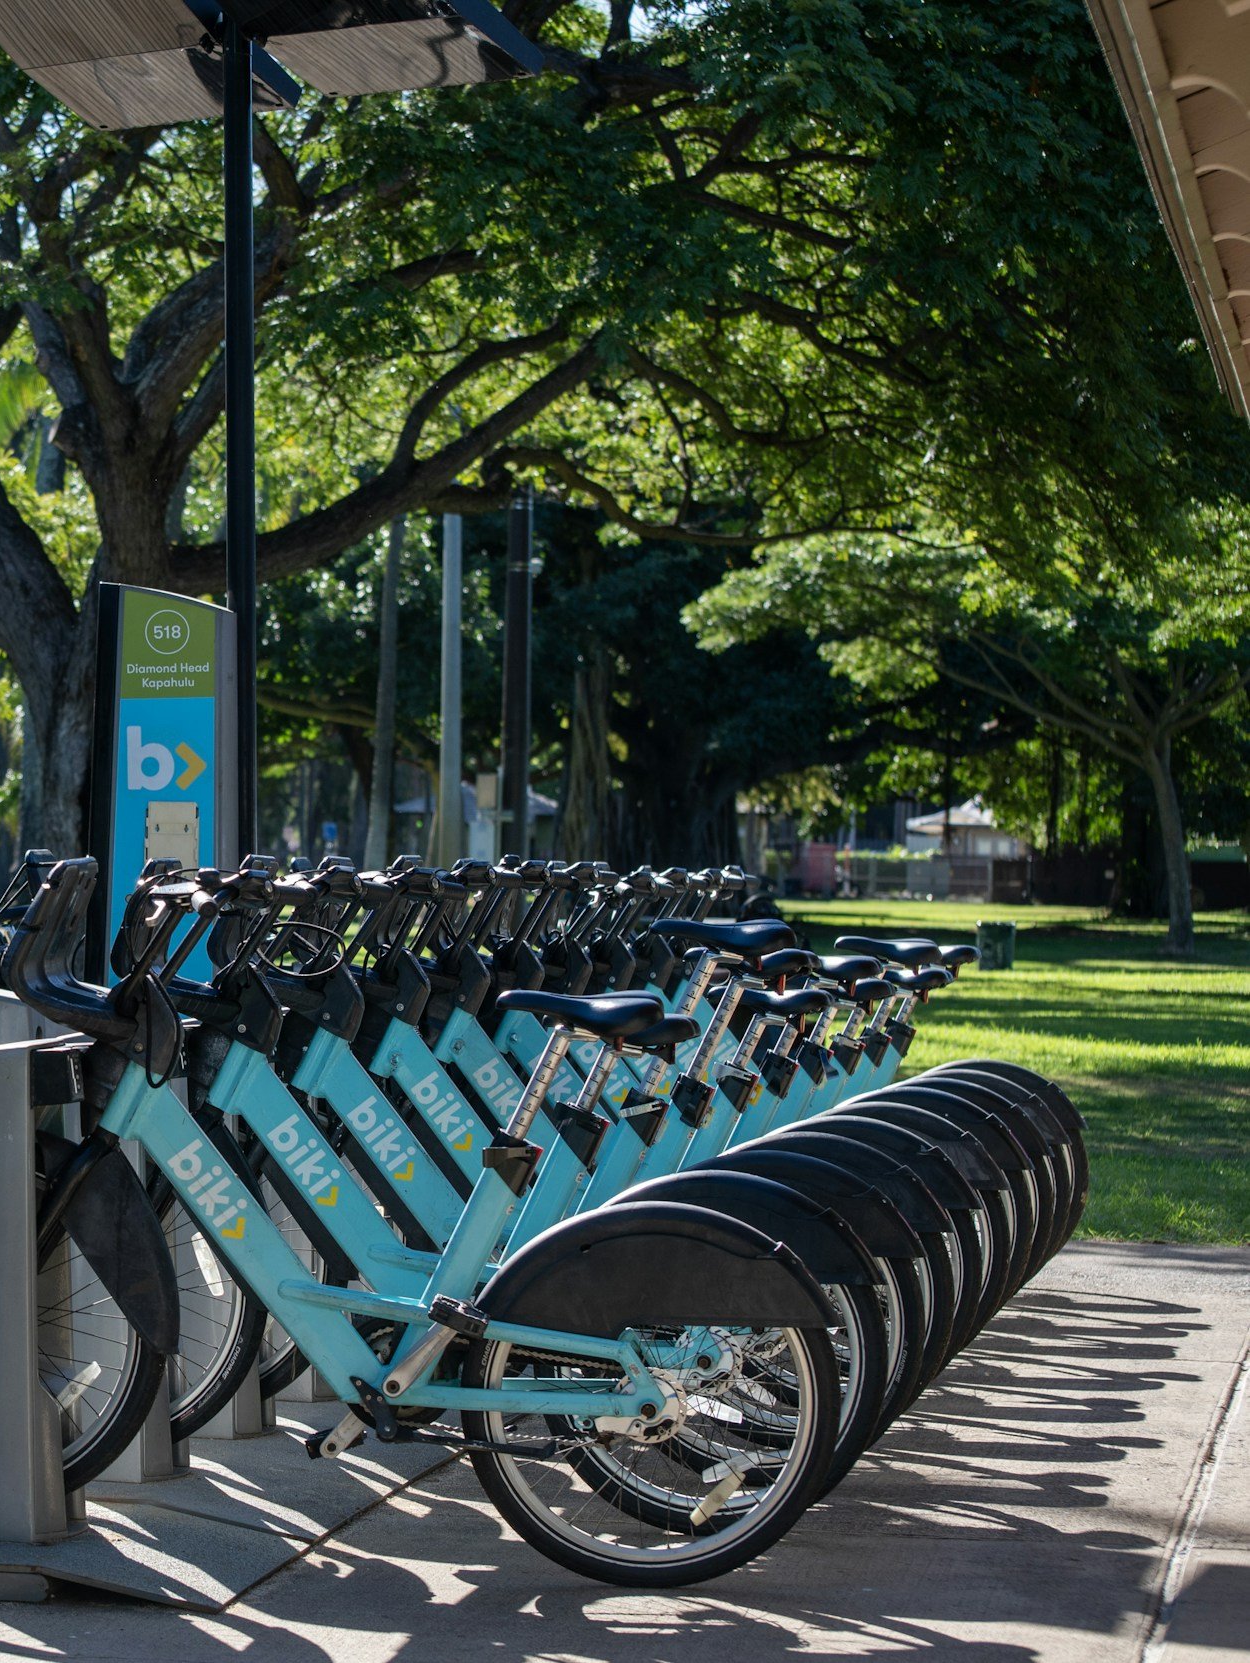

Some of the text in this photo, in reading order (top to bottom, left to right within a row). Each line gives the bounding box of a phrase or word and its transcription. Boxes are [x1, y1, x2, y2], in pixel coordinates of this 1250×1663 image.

[153, 625, 181, 639] 518
[126, 662, 210, 674] Diamond Head
[142, 677, 195, 690] Kapahulu
[126, 725, 175, 791] b
[347, 1095, 416, 1172] biki
[411, 1071, 474, 1142] biki
[167, 1139, 248, 1228] biki
[267, 1114, 341, 1196] biki
[221, 1346, 241, 1380] CHAOYANG
